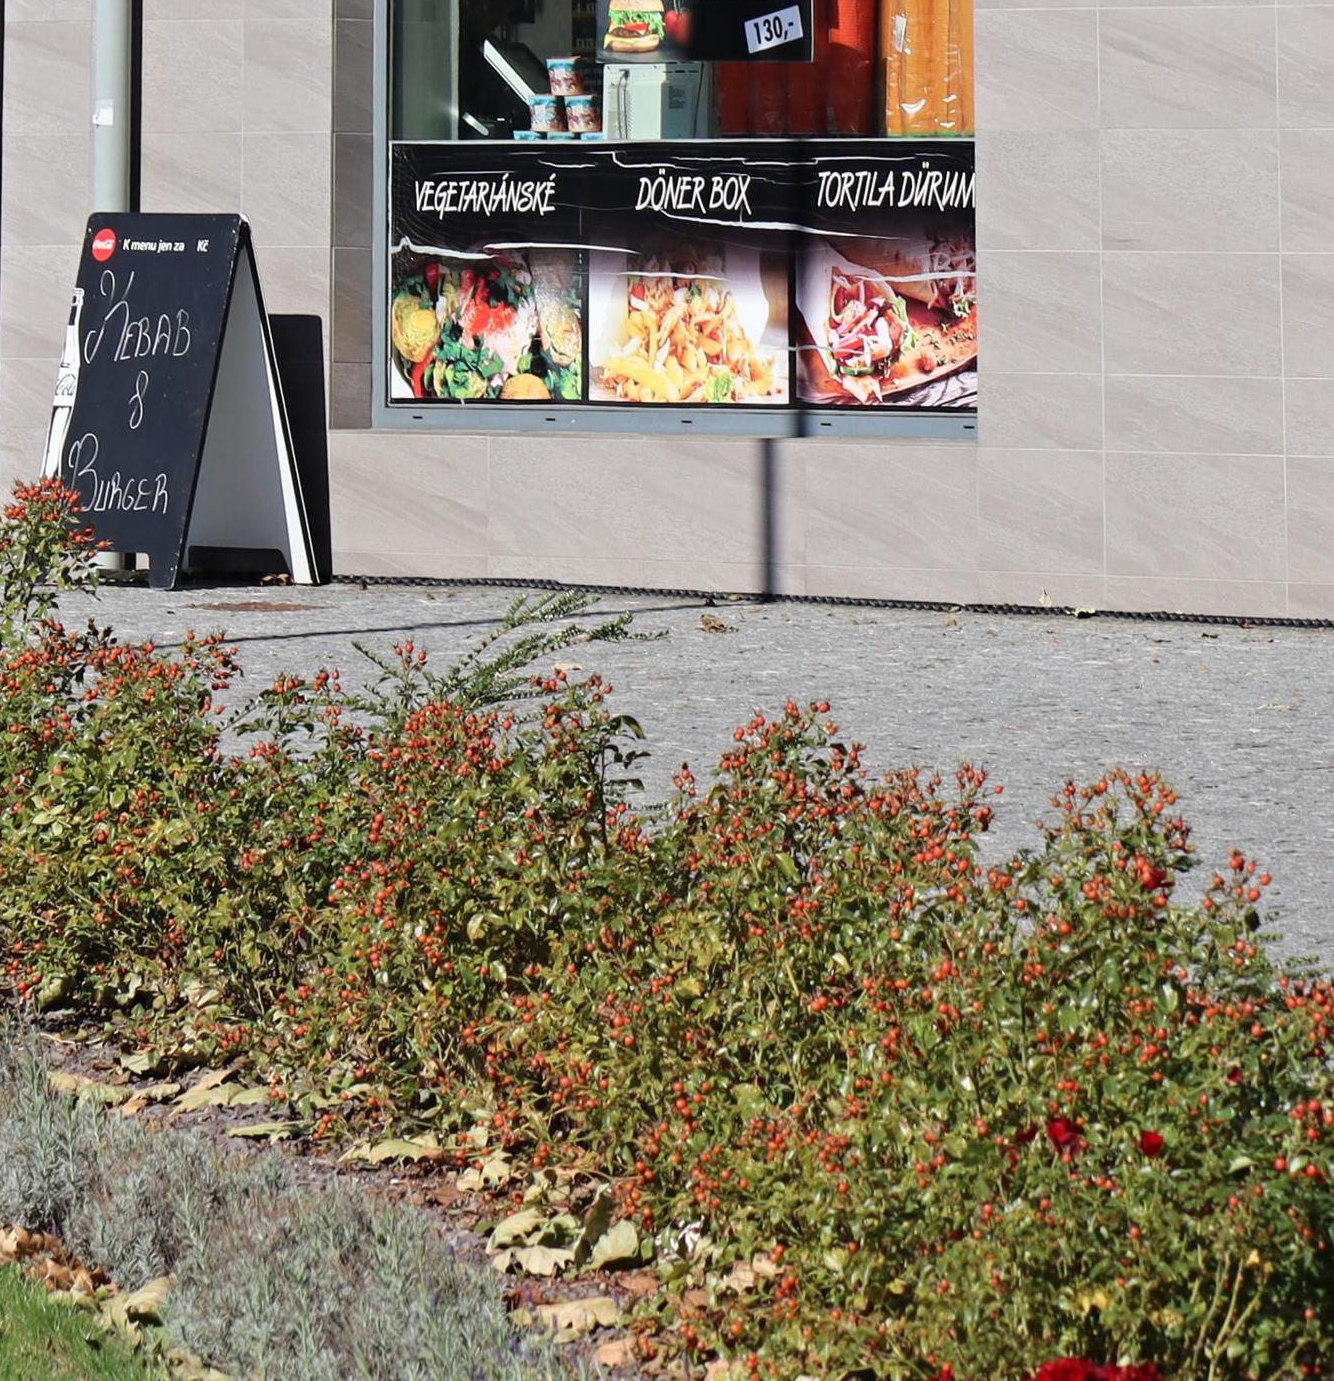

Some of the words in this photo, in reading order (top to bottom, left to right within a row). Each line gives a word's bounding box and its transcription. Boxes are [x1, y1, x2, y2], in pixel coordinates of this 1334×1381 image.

[753, 16, 794, 45] 130,-
[415, 173, 556, 220] VEGETARIÁNSKÉ
[635, 168, 706, 214] DÖNER
[709, 174, 752, 215] BOX
[817, 170, 895, 212] TORTILA
[122, 239, 130, 251] K
[131, 241, 157, 251] menu
[157, 239, 172, 253] jen
[173, 241, 185, 252] za
[196, 239, 209, 252] Kč
